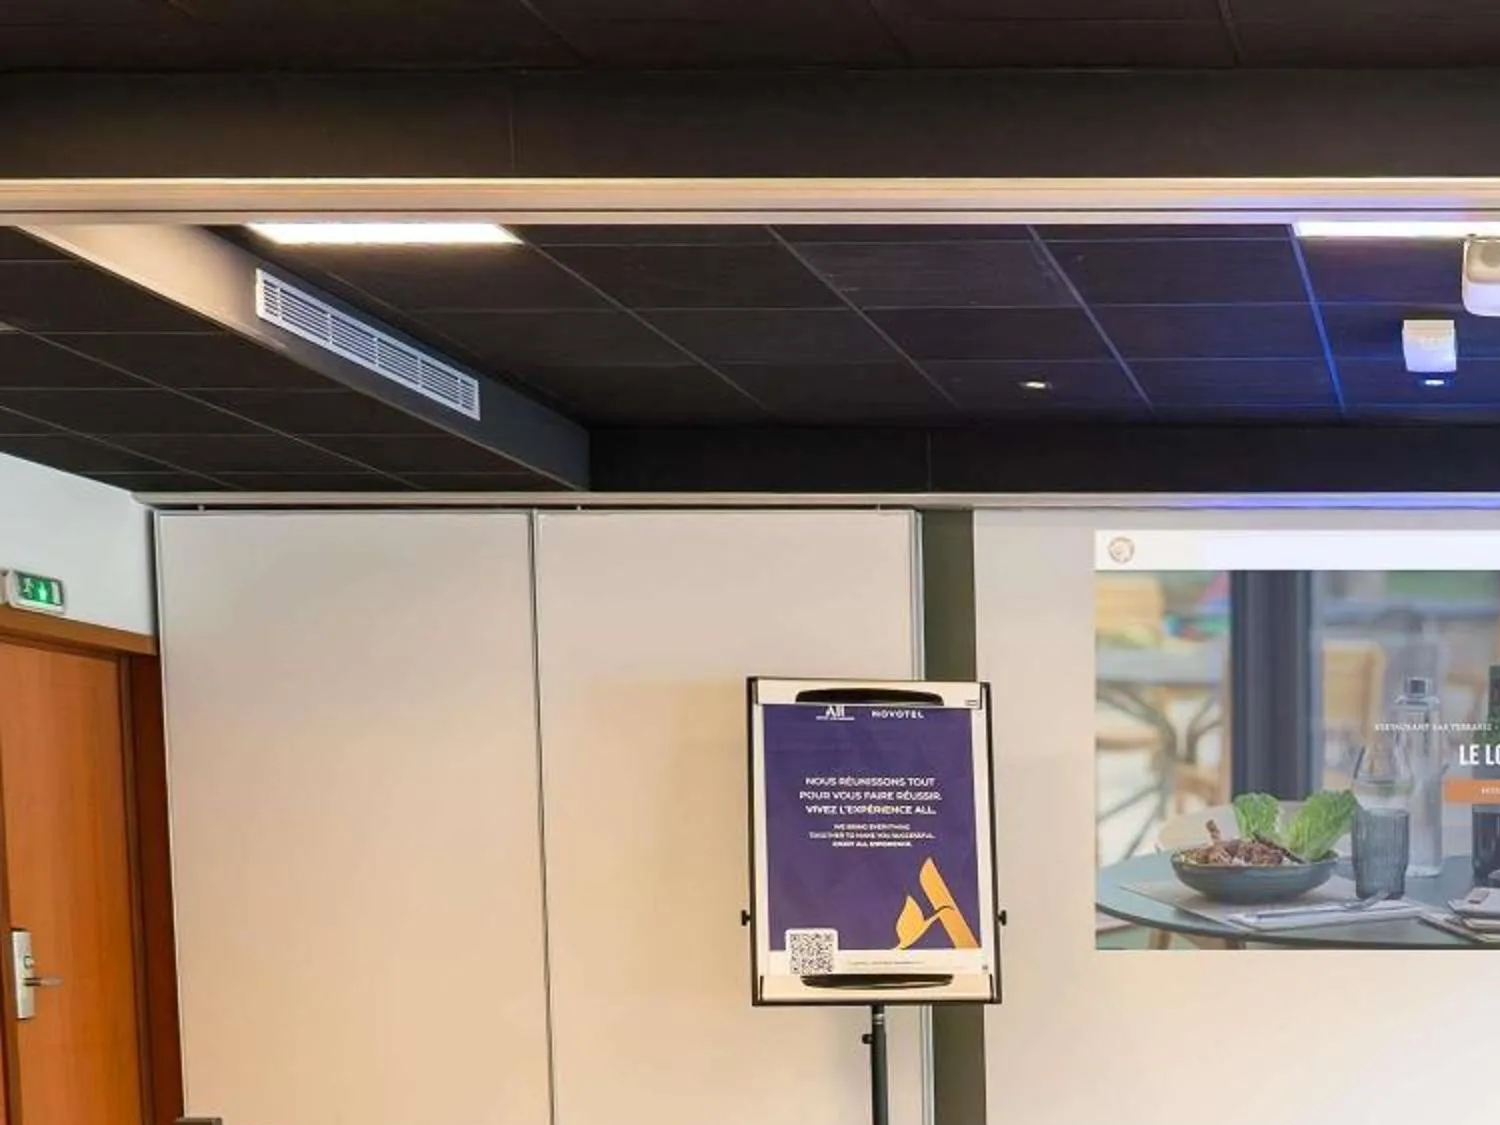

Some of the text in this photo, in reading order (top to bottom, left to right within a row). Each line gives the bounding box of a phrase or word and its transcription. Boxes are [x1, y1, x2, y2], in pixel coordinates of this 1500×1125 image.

[871, 709, 925, 719] NOVOTEL
[1459, 743, 1480, 766] LE
[805, 775, 936, 787] NOUS RÉUNISSONS TOUT
[799, 789, 943, 801] POUR VOUS FAIRE RÉUSSIR.
[805, 803, 937, 815] VIVEZ L'EXPÉRIENCE ALL.
